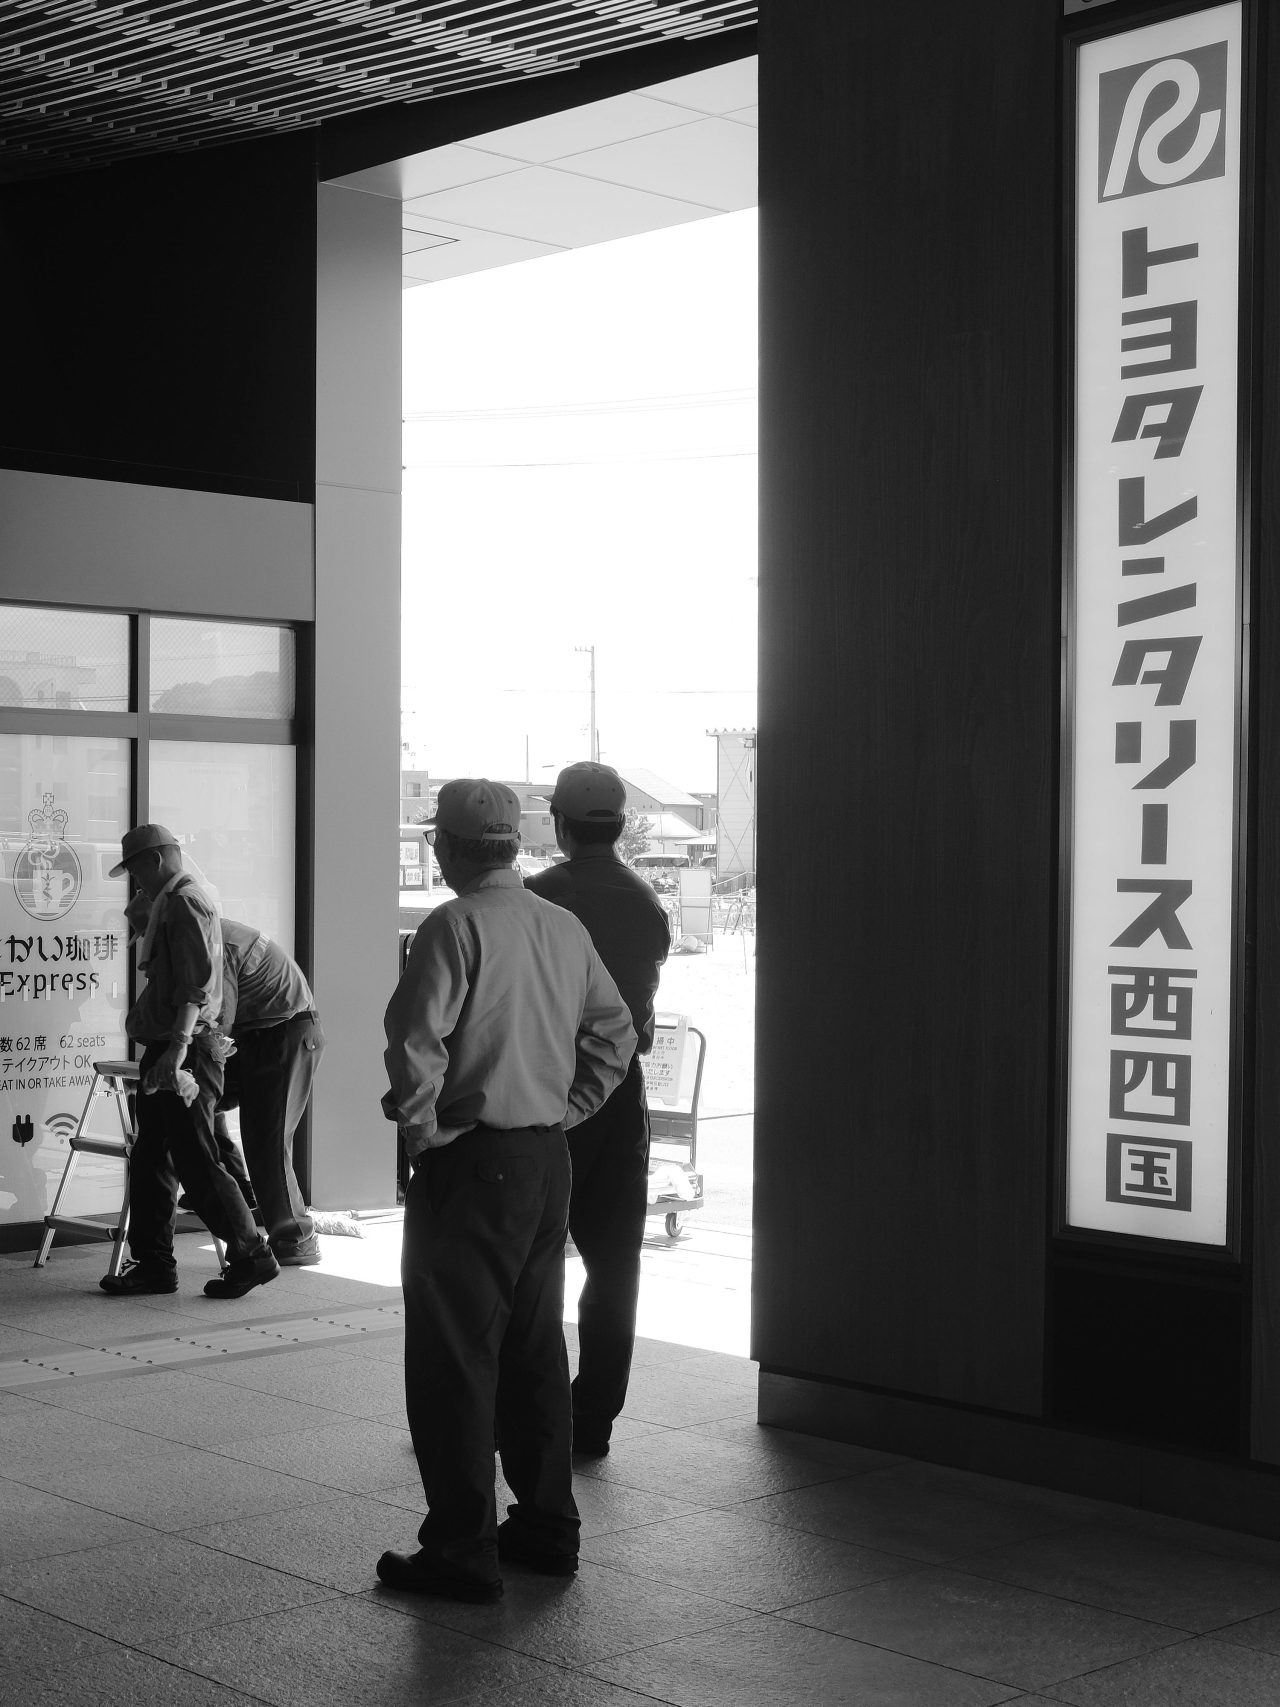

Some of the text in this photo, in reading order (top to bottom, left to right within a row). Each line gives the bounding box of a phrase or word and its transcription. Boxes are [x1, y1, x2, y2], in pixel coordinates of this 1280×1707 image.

[1106, 226, 1204, 1212] トヨタレンタリース西四国
[59, 1034, 74, 1049] 62
[77, 1034, 106, 1048] seats
[74, 1054, 92, 1069] OK
[15, 1079, 26, 1090] IN
[28, 1078, 42, 1090] OR
[44, 1076, 67, 1088] TAKE
